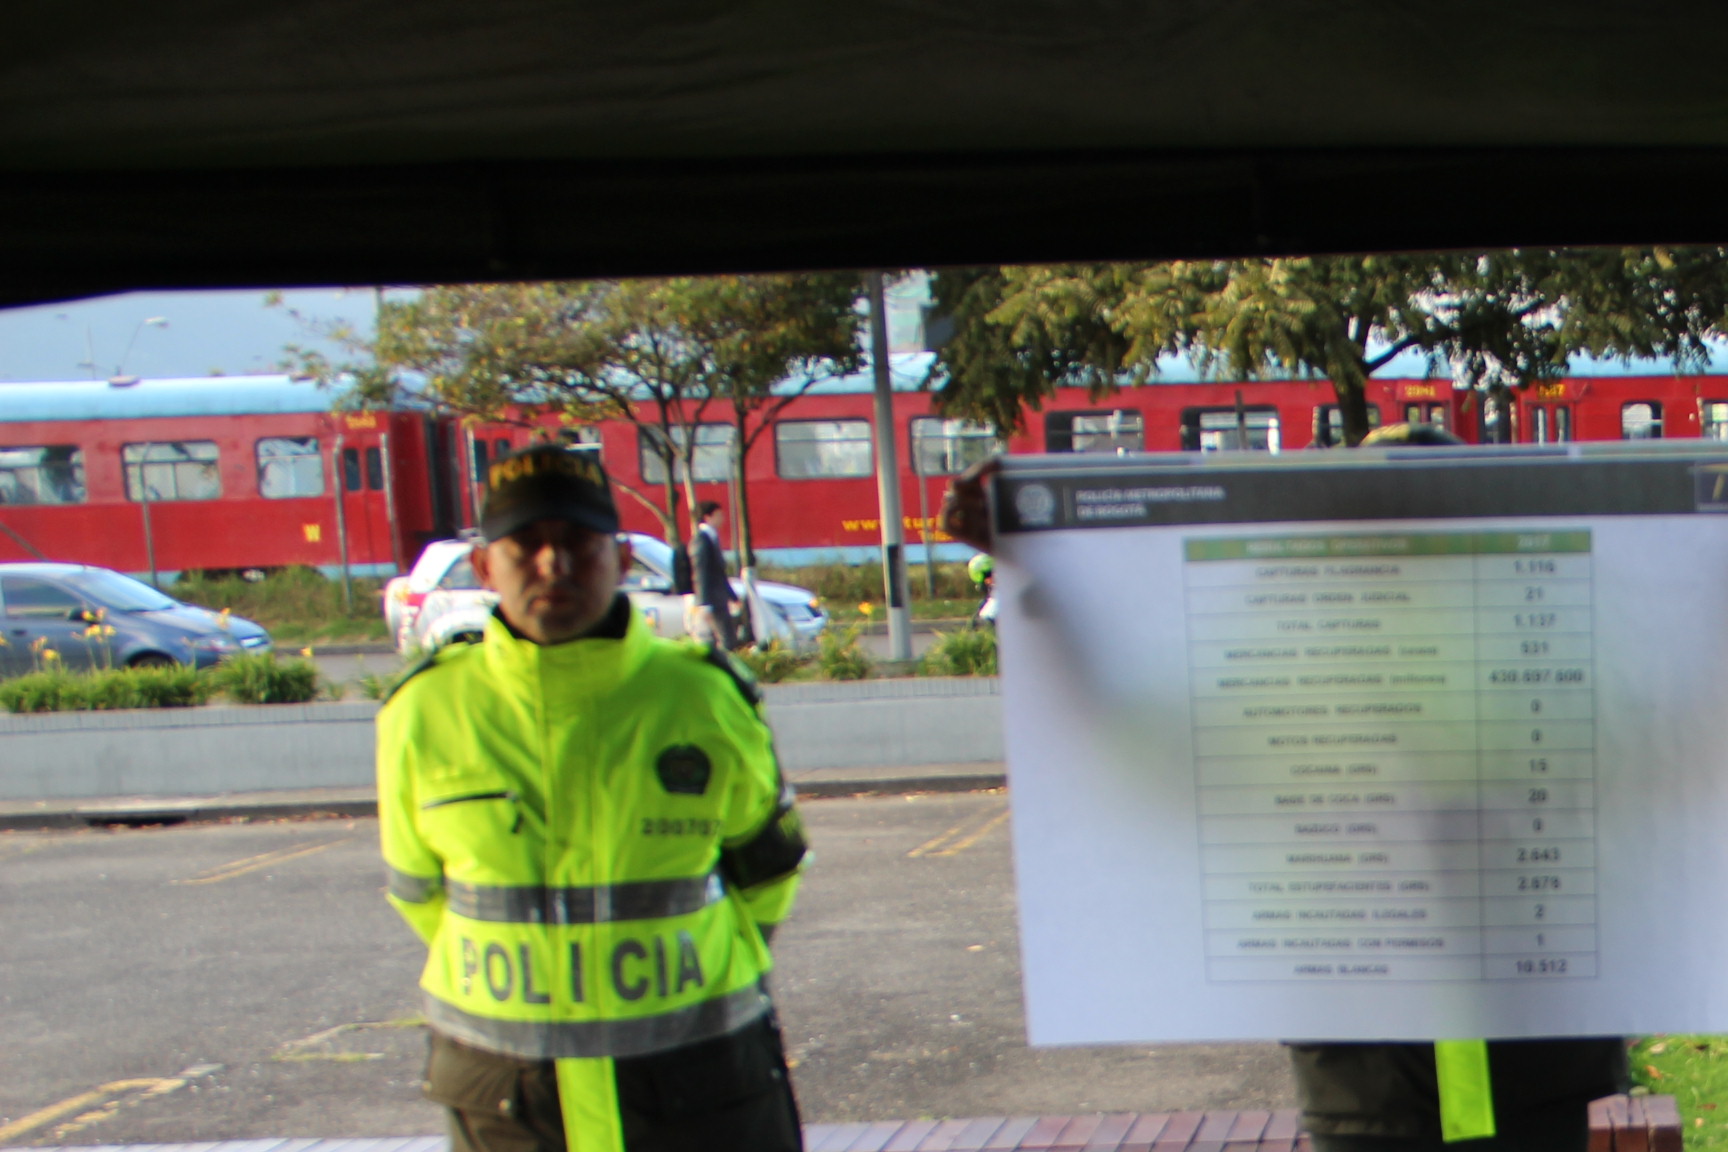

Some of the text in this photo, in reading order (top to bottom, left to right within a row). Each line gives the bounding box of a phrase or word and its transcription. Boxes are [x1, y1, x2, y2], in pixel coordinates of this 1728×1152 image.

[1525, 587, 1543, 600] 21
[1535, 905, 1544, 918] 2
[462, 930, 704, 1004] POLICIA
